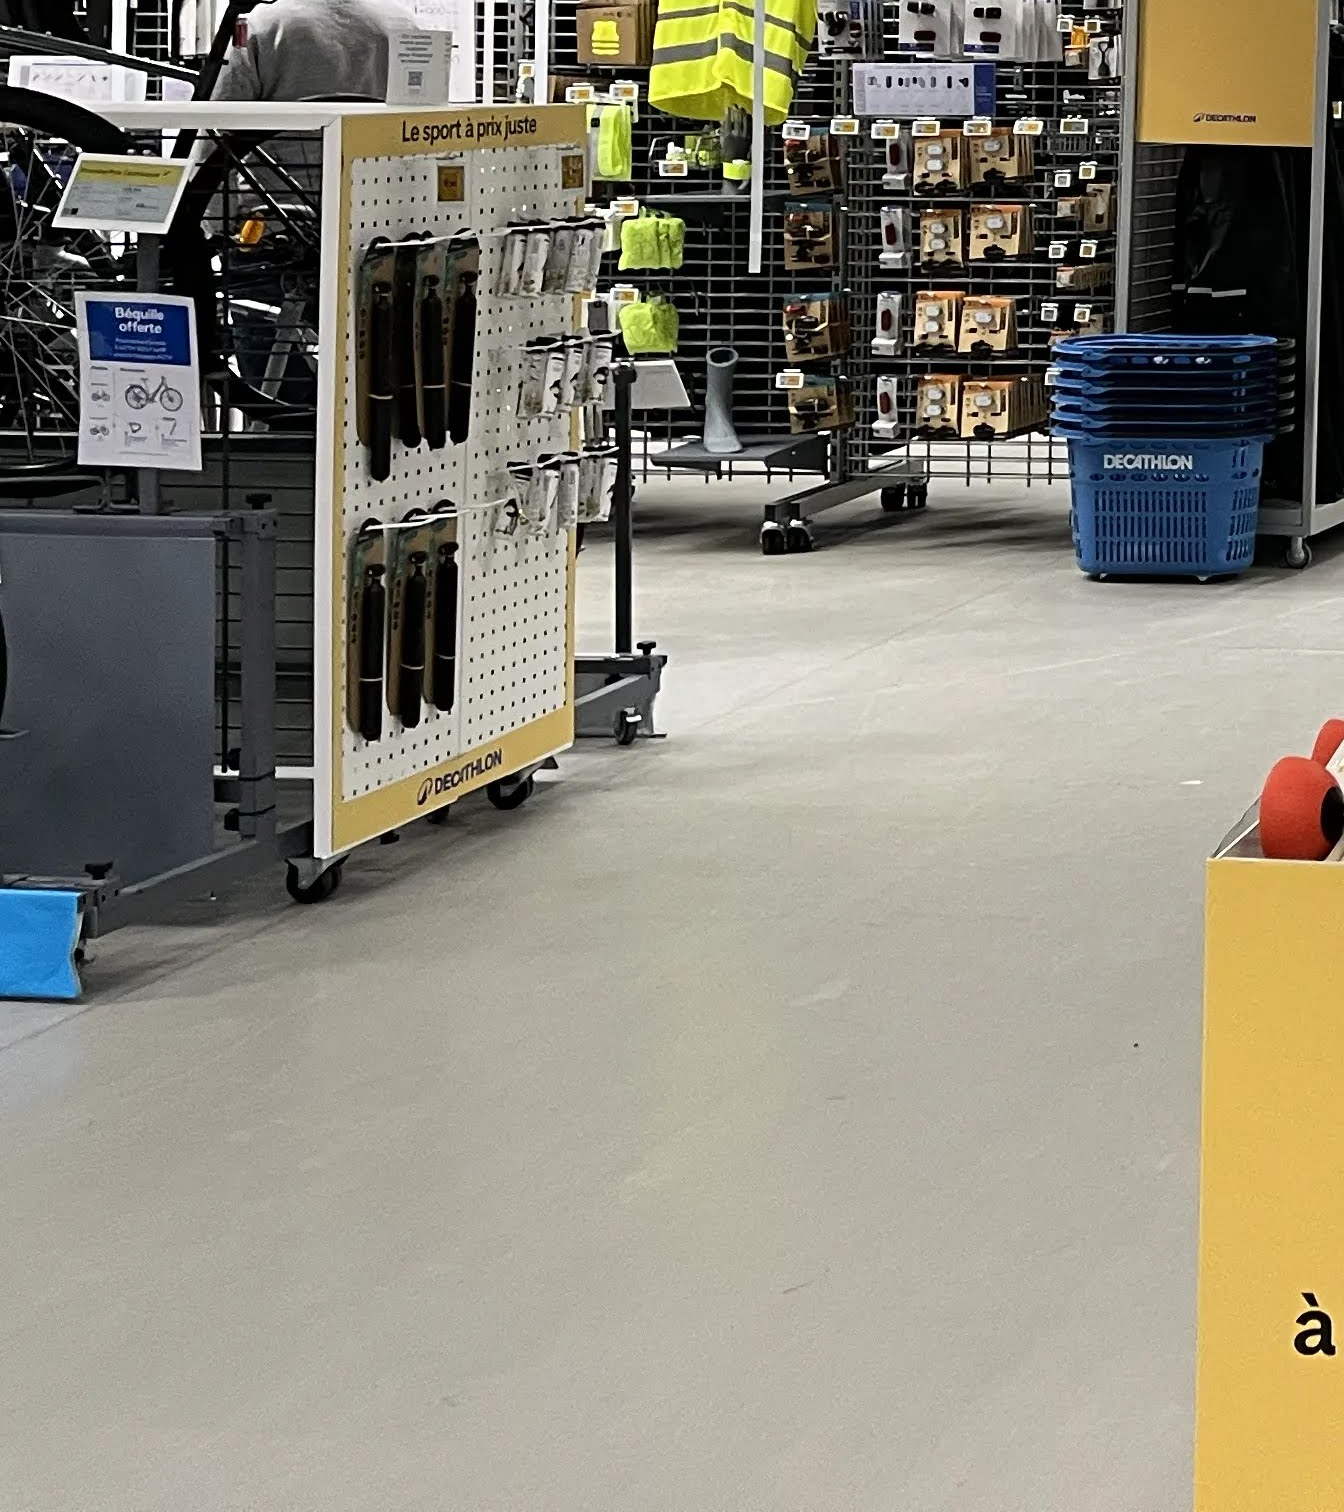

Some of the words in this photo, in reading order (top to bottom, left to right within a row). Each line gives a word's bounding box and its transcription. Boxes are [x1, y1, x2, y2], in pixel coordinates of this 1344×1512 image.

[1205, 113, 1257, 123] DECATHLON
[402, 120, 420, 143] Le
[422, 119, 462, 145] sport
[465, 117, 474, 138] à
[476, 115, 503, 143] prix
[503, 115, 537, 141] juste
[114, 307, 165, 323] Béquille
[118, 322, 163, 334] offerte
[1103, 454, 1193, 470] DECATHLON
[434, 747, 503, 795] DECATHLON
[1293, 1292, 1336, 1357] à
